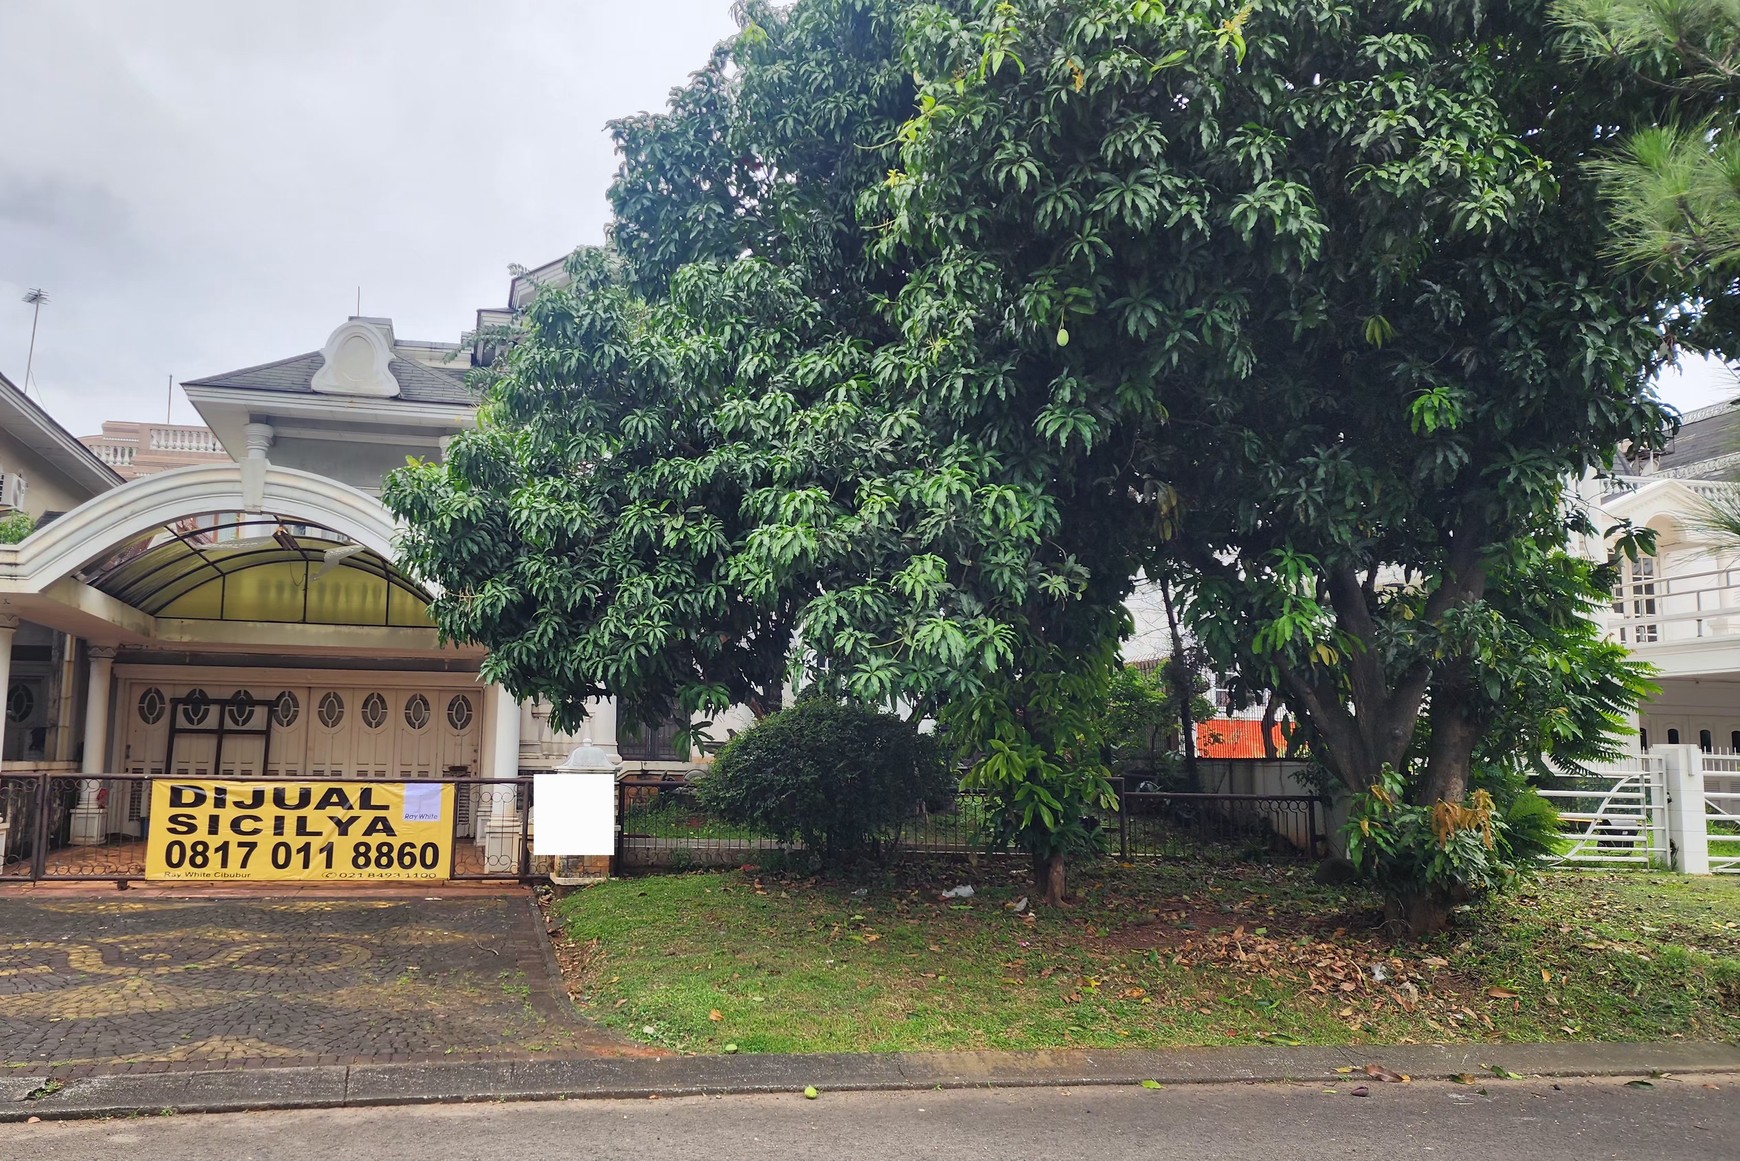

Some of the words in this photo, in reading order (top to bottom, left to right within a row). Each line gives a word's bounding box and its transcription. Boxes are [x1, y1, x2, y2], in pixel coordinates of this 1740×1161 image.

[169, 785, 390, 810] DIJUAL
[166, 813, 397, 837] SICILYA
[404, 812, 418, 820] Ray
[418, 812, 438, 820] White
[165, 840, 258, 869] 0817
[271, 841, 335, 870] 011
[351, 842, 440, 870] 8860
